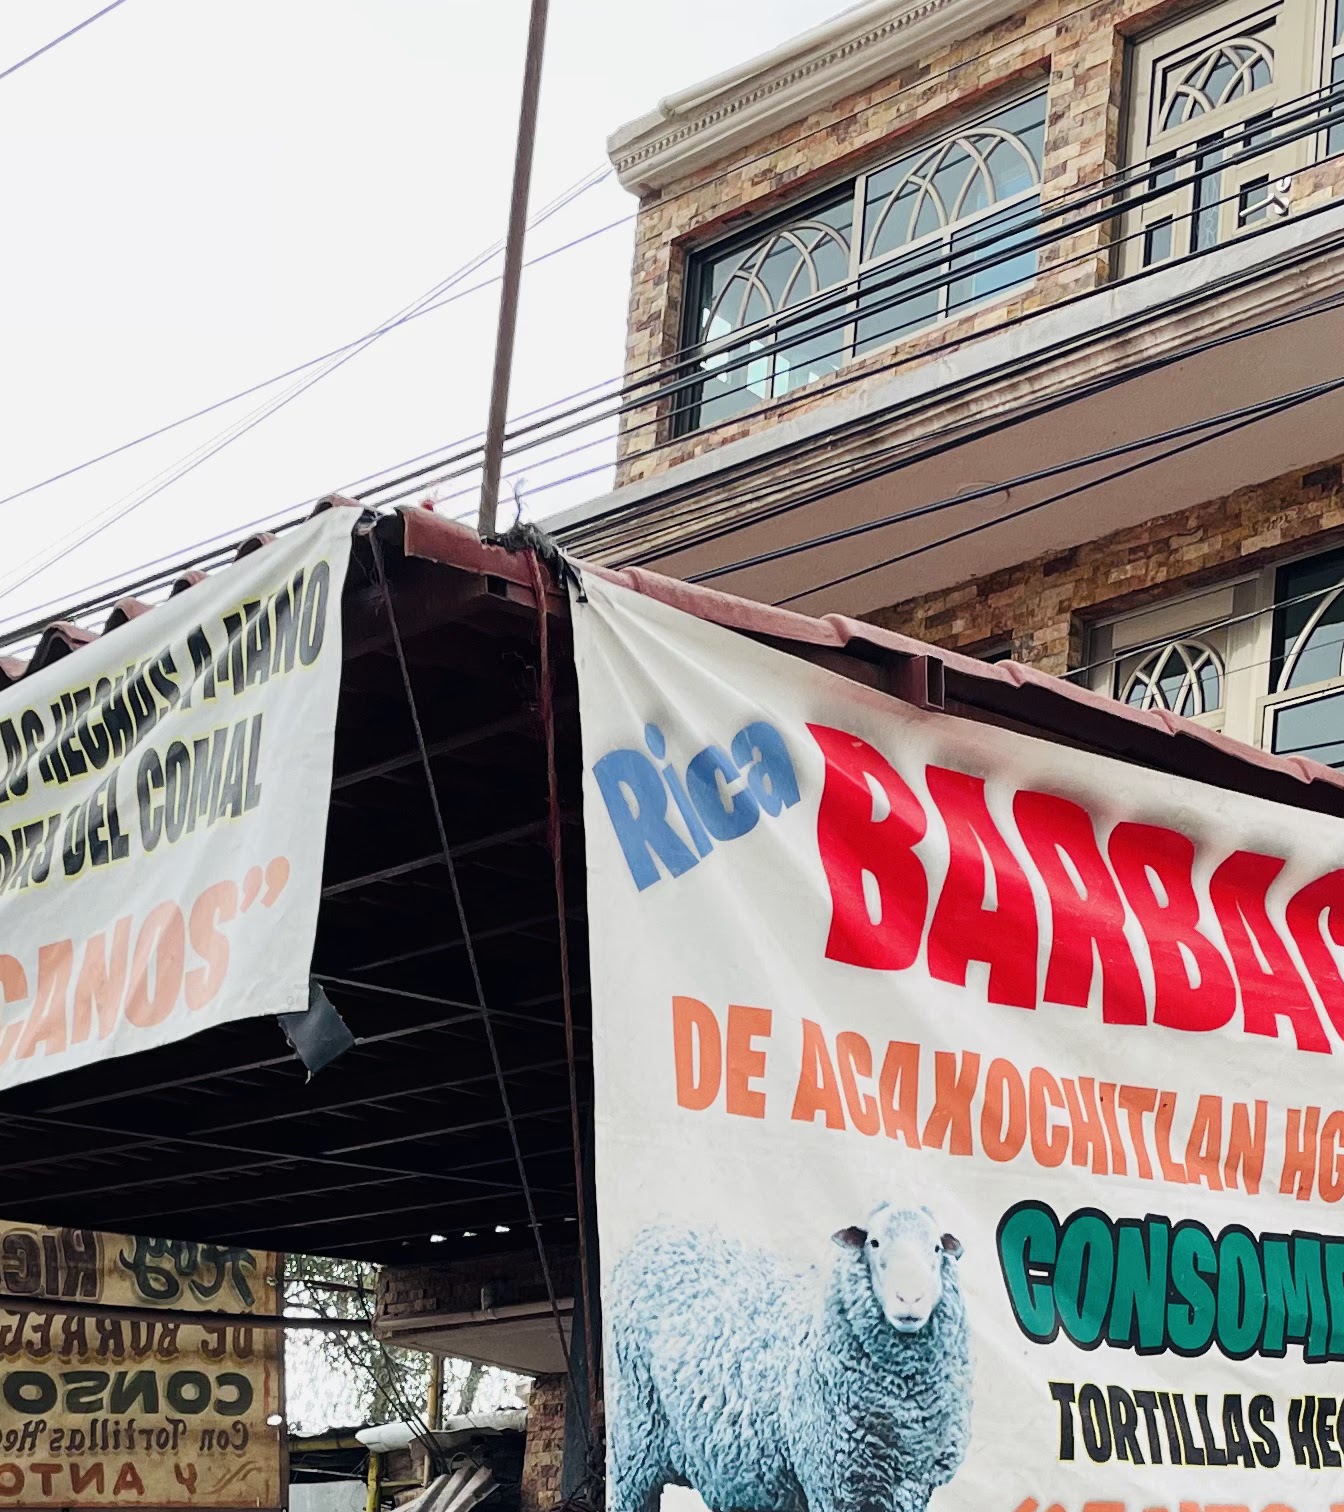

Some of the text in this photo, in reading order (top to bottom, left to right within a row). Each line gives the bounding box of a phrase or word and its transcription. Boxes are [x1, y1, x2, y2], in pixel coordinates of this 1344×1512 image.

[62, 765, 130, 877] DEL
[137, 713, 263, 853] COMAL
[592, 721, 801, 893] Rica
[672, 995, 773, 1119] DE
[791, 1018, 1268, 1197] ACAXOCHITLAN
[1047, 1380, 1281, 1469] TORTILLAS
